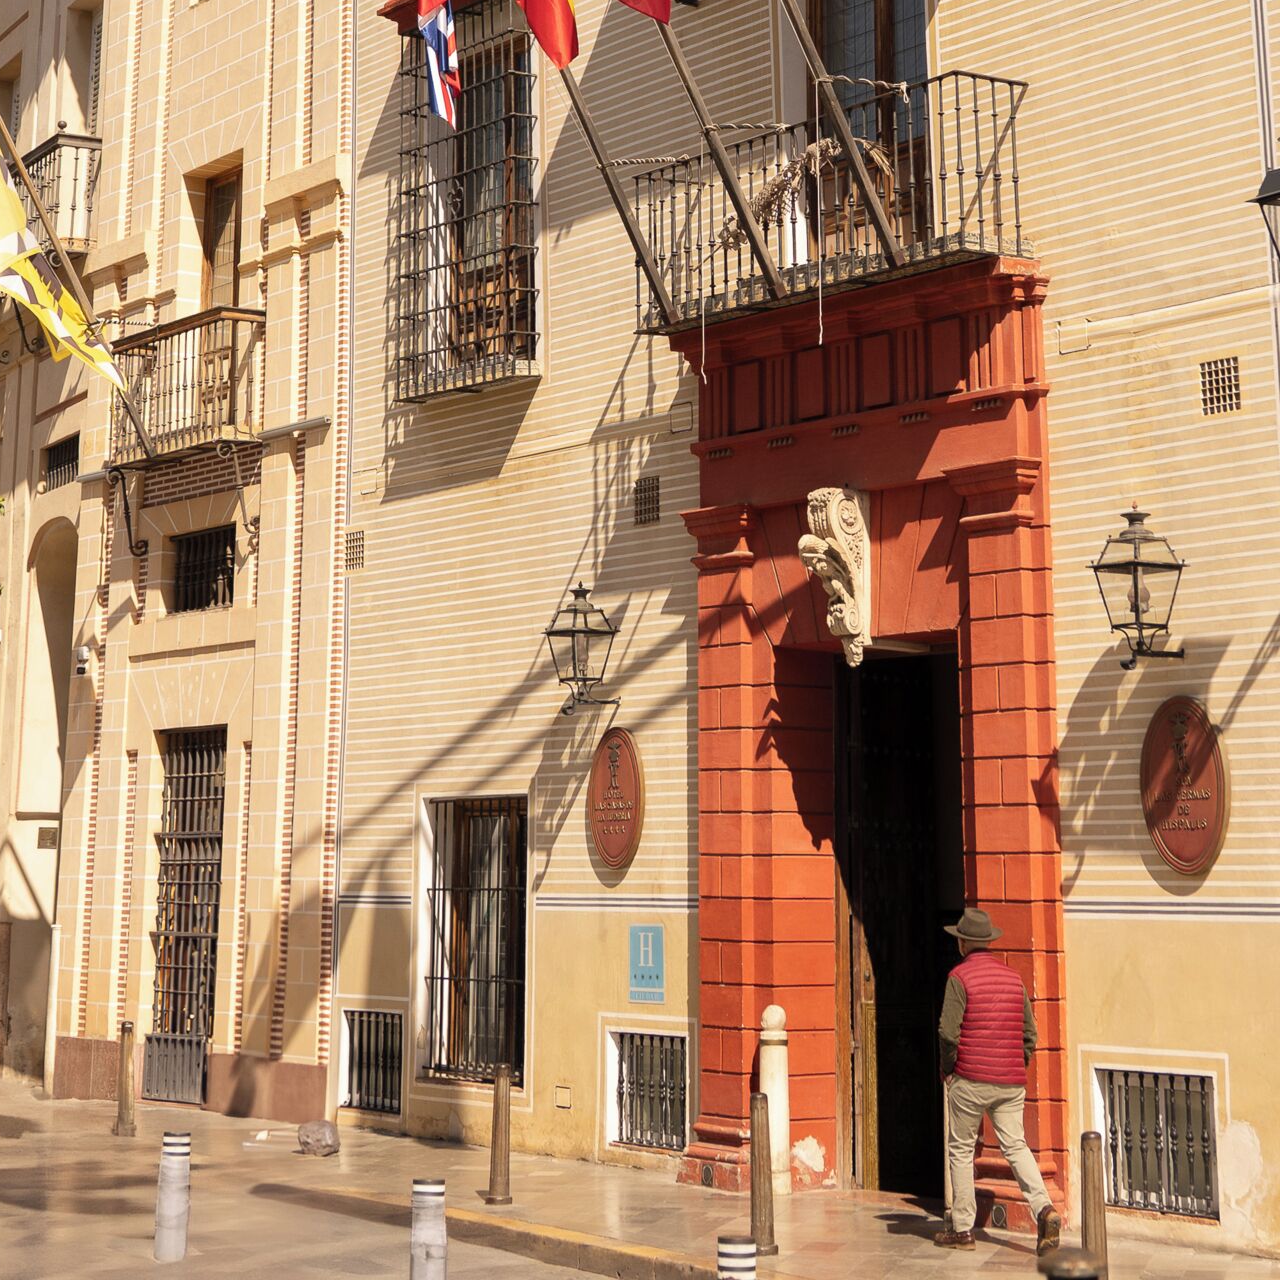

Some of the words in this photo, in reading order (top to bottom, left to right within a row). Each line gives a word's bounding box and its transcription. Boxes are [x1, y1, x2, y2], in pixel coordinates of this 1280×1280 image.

[603, 790, 624, 800] HOTEL
[1176, 788, 1211, 802] TERMAS
[1177, 803, 1191, 816] DE
[1162, 818, 1208, 831] HISPALIS
[637, 931, 656, 968] H
